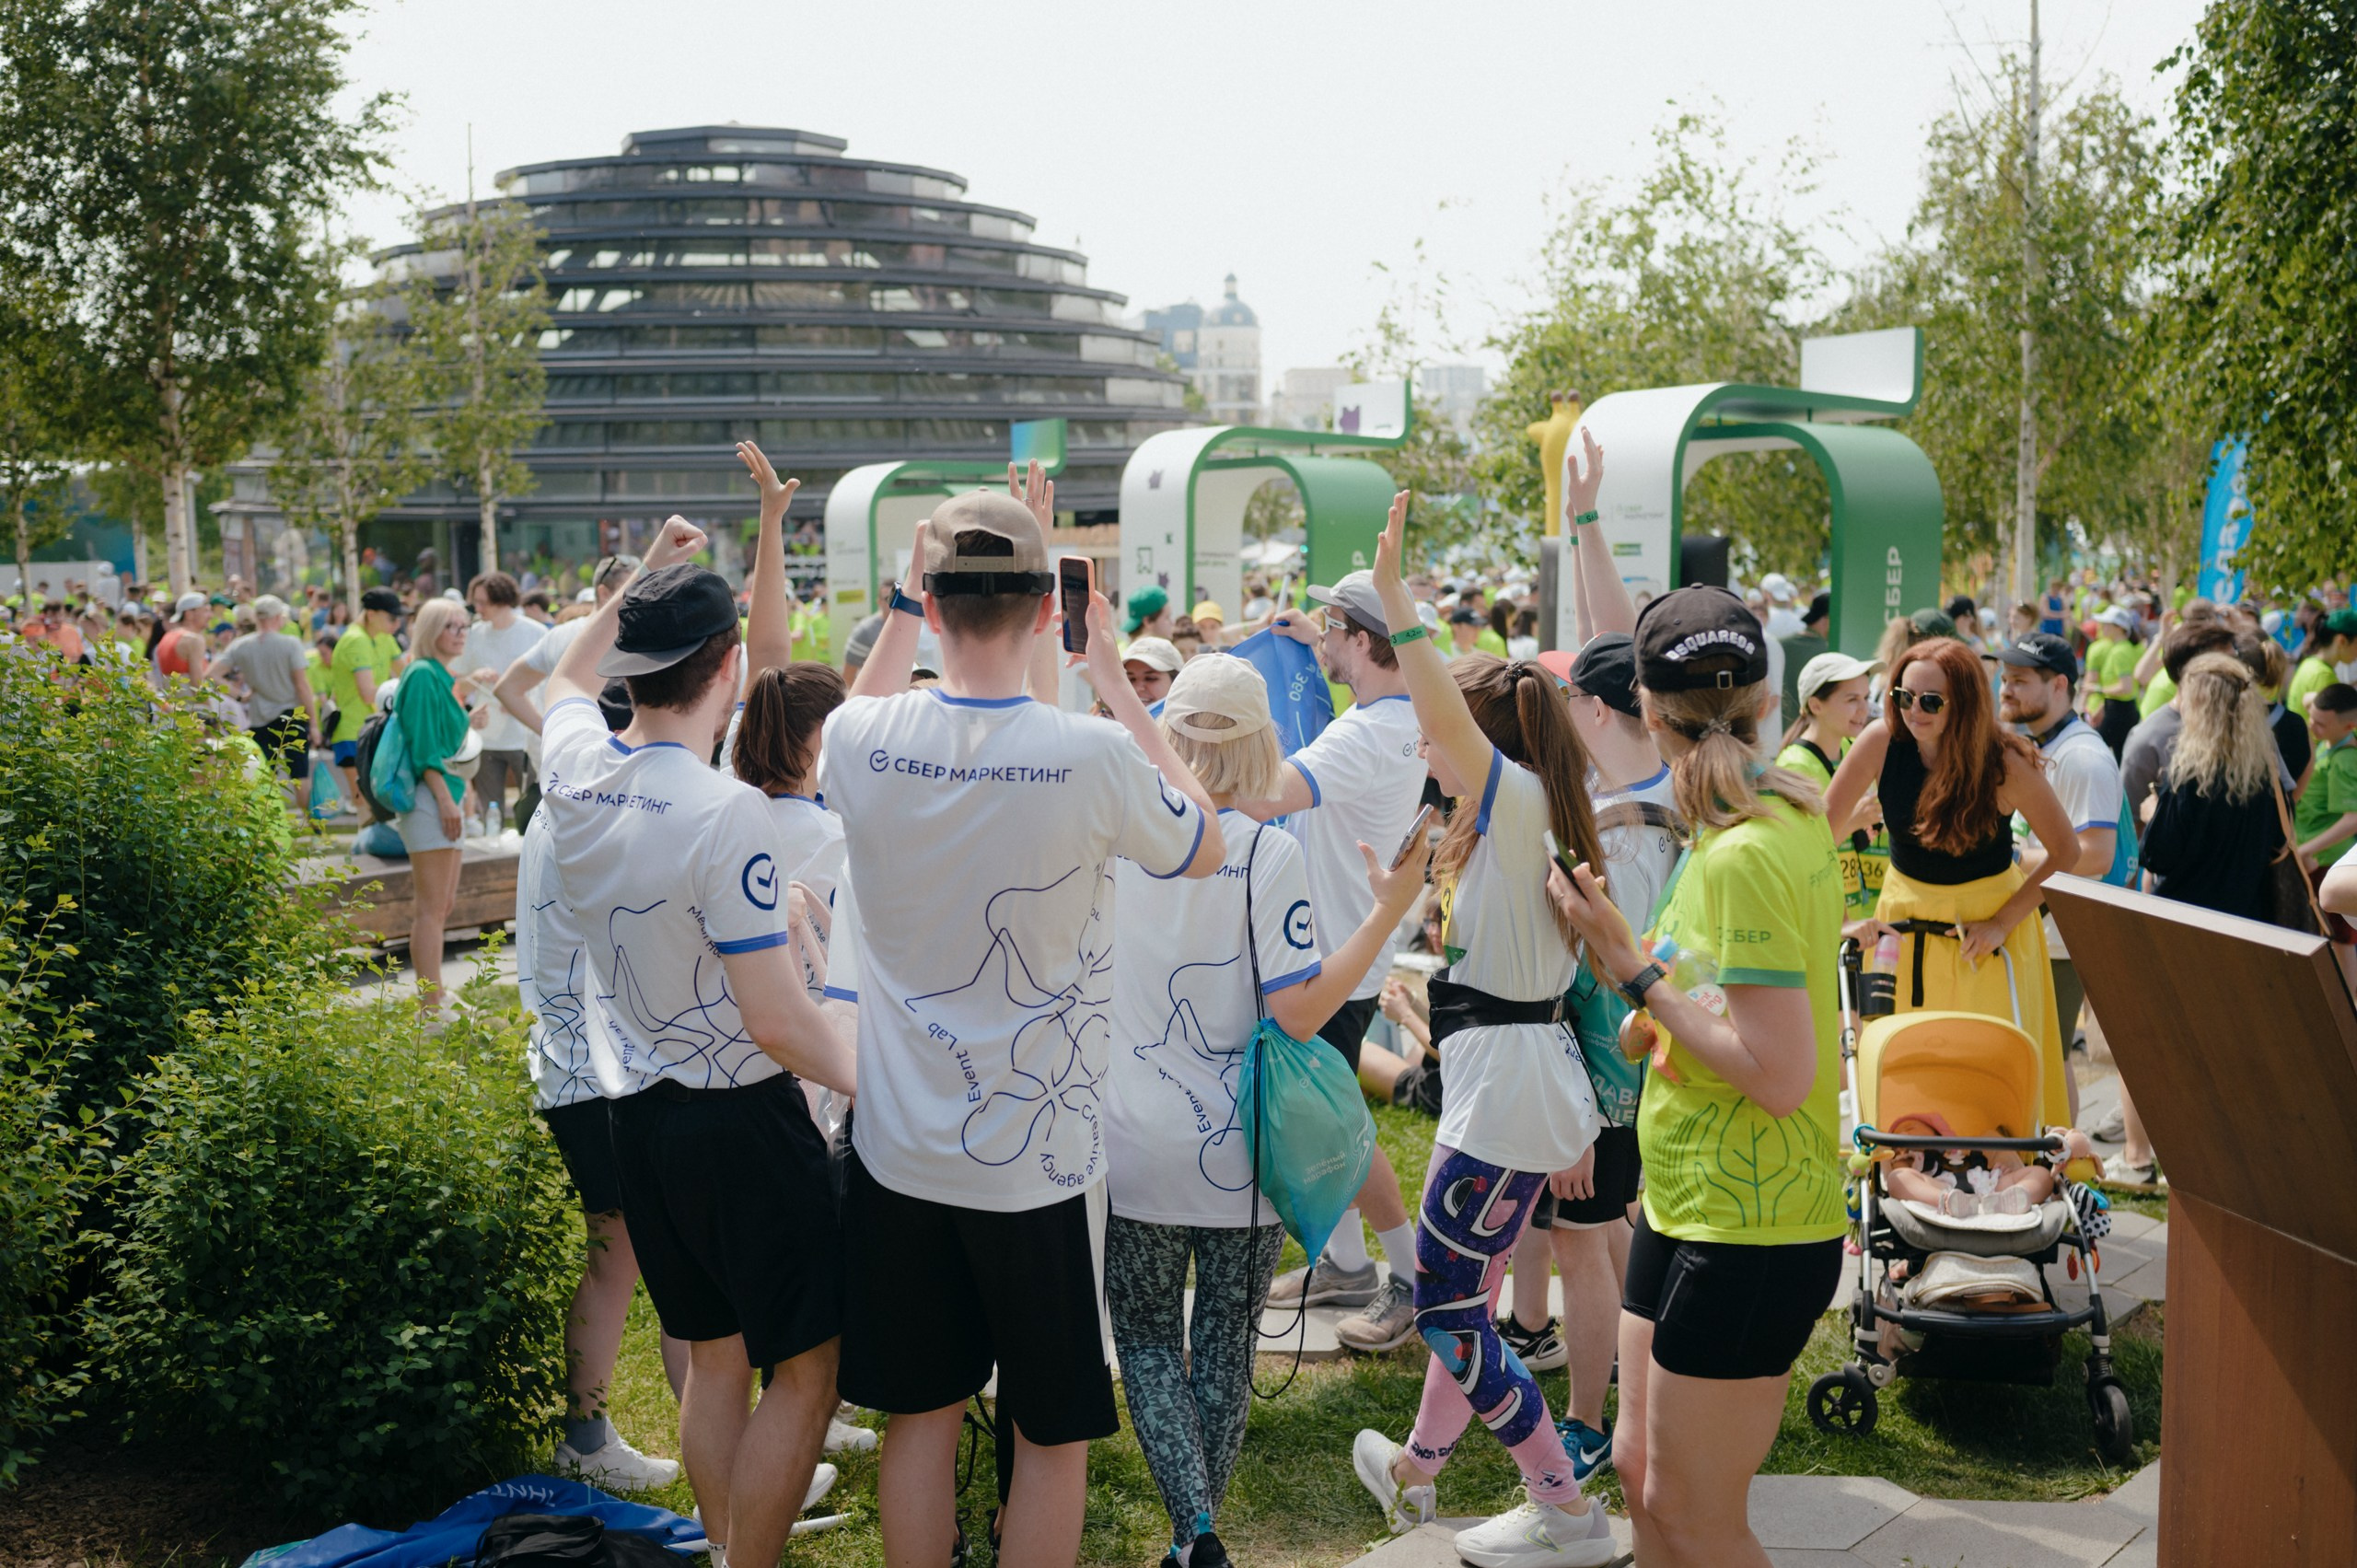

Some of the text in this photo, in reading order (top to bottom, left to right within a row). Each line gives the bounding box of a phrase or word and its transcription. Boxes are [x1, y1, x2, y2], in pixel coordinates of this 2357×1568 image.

[894, 757, 1073, 784] СБЕР МАРКЕТИНГ
[596, 792, 672, 815] МАРЕТИНГ
[928, 1023, 981, 1103] Event Lab
[1040, 1152, 1085, 1188] agency
